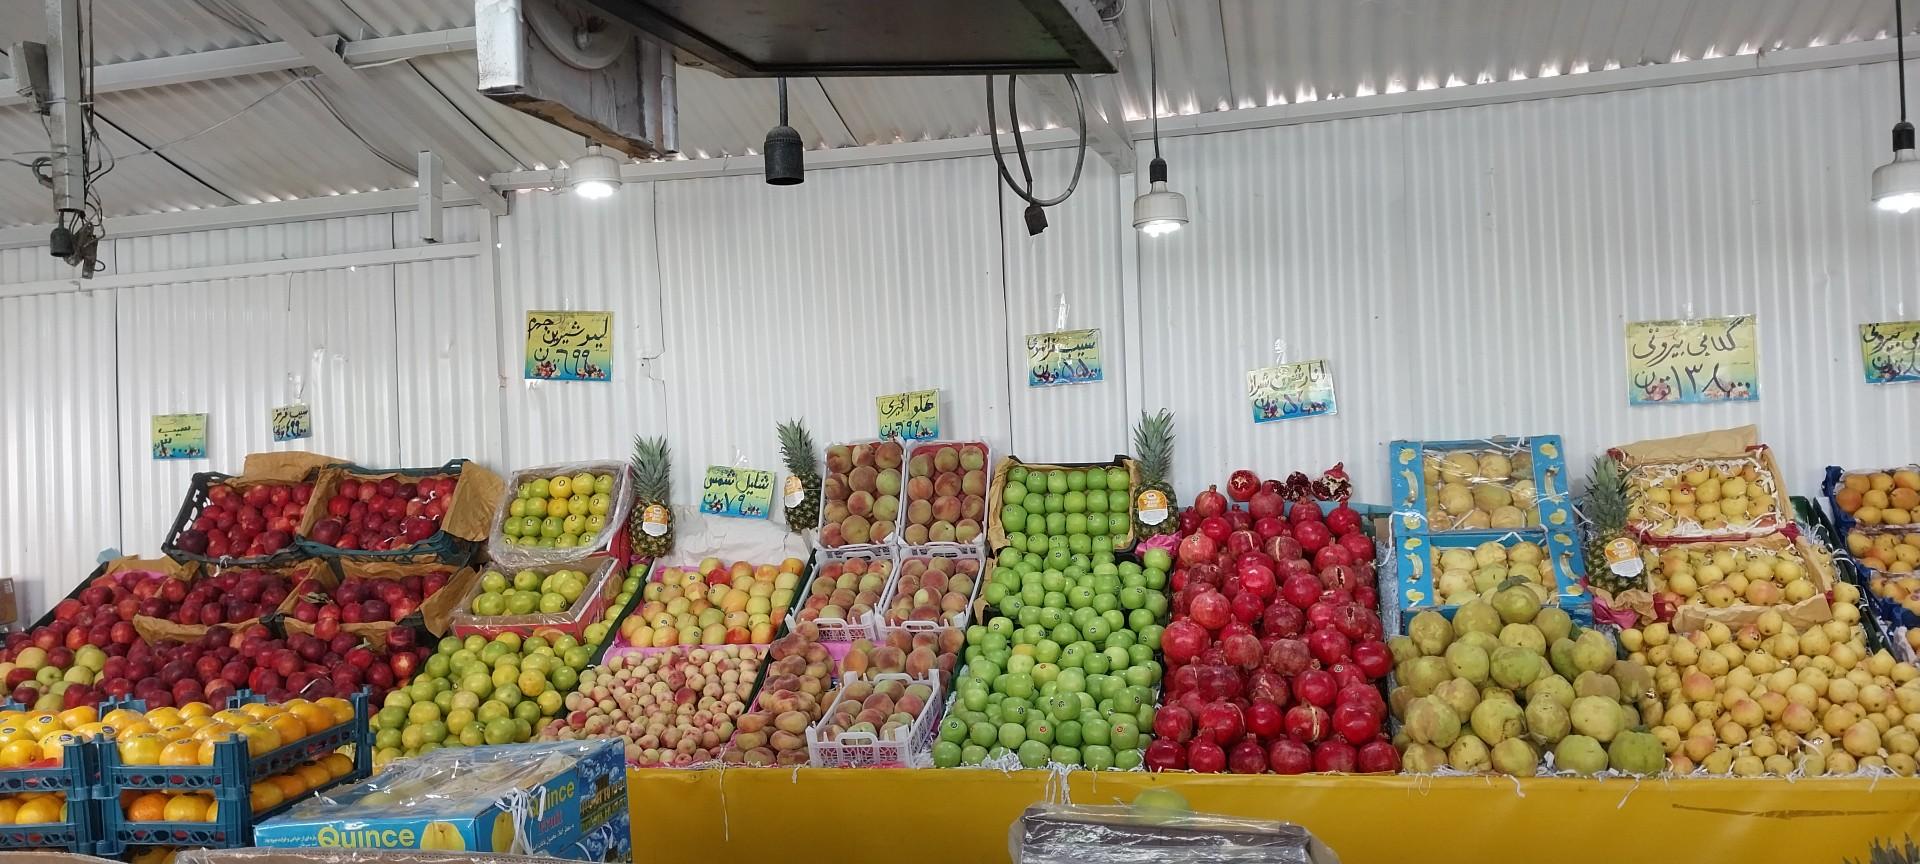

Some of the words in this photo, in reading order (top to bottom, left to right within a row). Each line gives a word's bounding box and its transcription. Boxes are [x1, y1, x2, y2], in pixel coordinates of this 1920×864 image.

[543, 321, 585, 347] شیرین
[1687, 317, 1745, 356] گلابی
[736, 472, 770, 495] شلیل
[317, 826, 415, 849] Quince
